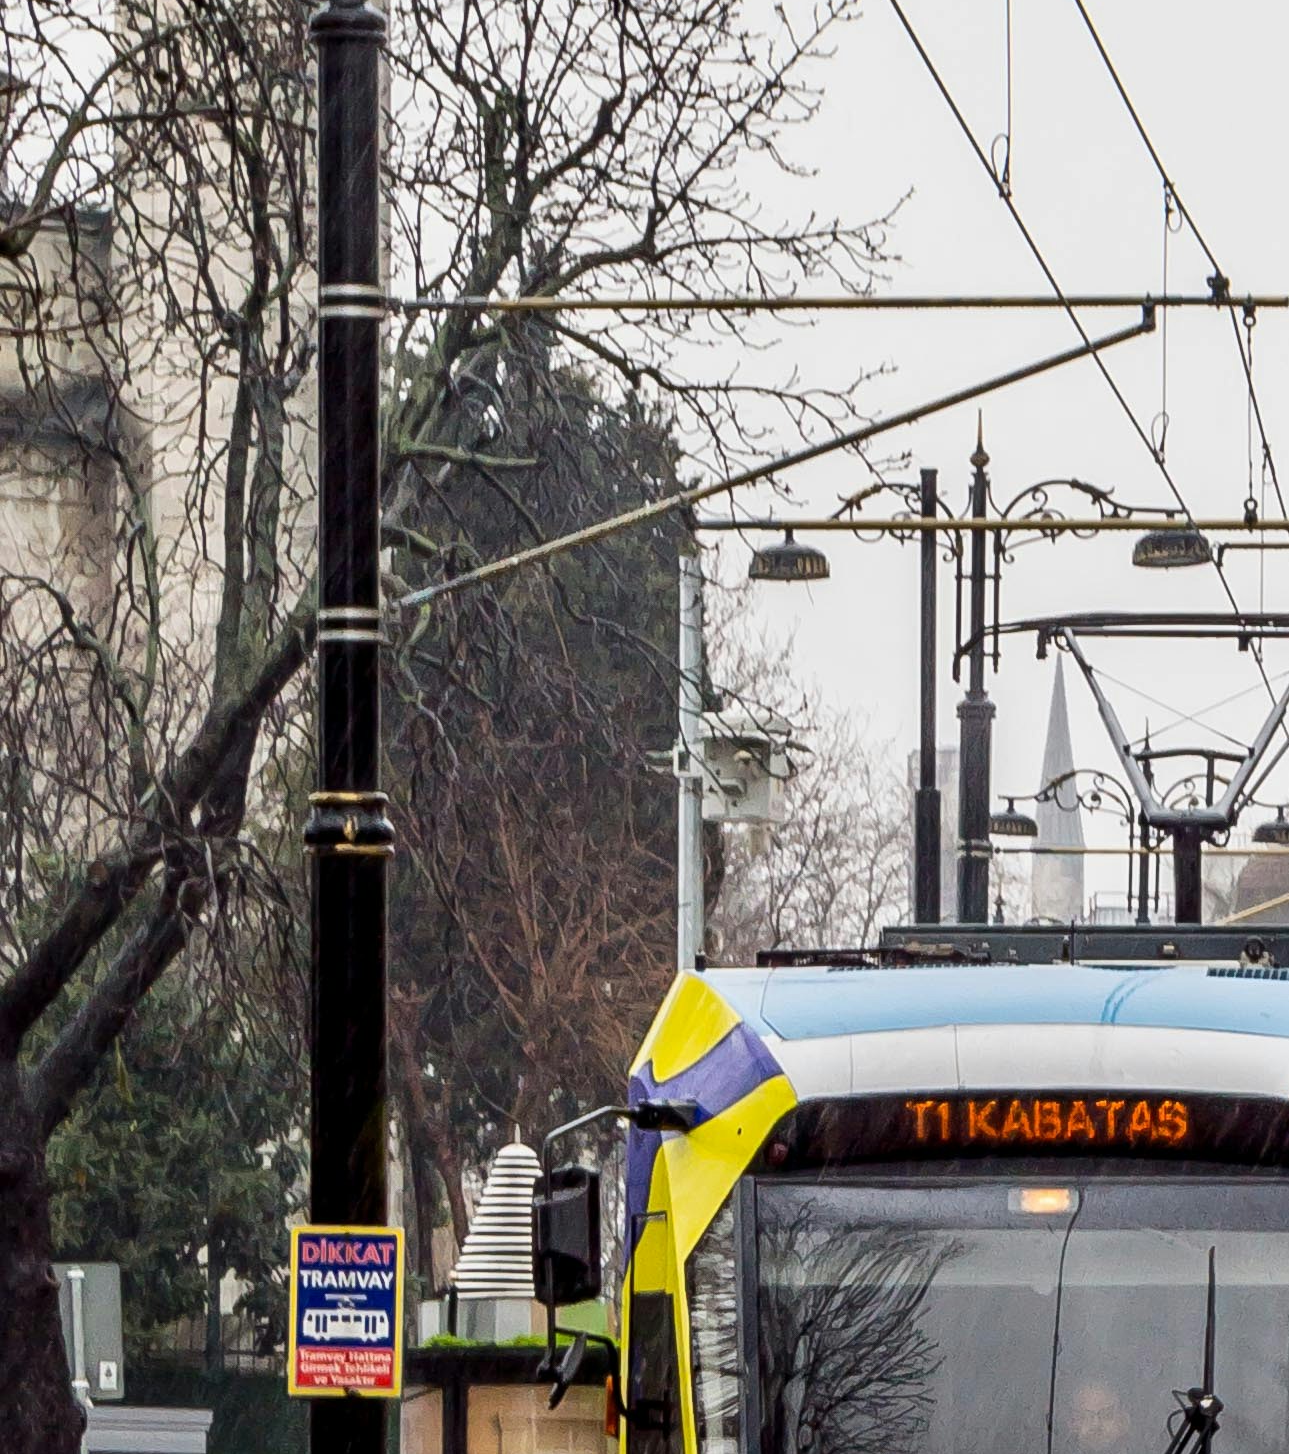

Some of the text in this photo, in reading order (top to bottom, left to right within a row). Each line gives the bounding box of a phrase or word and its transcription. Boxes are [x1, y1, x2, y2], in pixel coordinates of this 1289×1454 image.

[905, 1099, 950, 1140] T1
[301, 1238, 395, 1266] DİKKAT
[299, 1269, 394, 1290] TRAMVAY
[299, 1348, 346, 1362] Tramvay
[313, 1376, 328, 1385] ve
